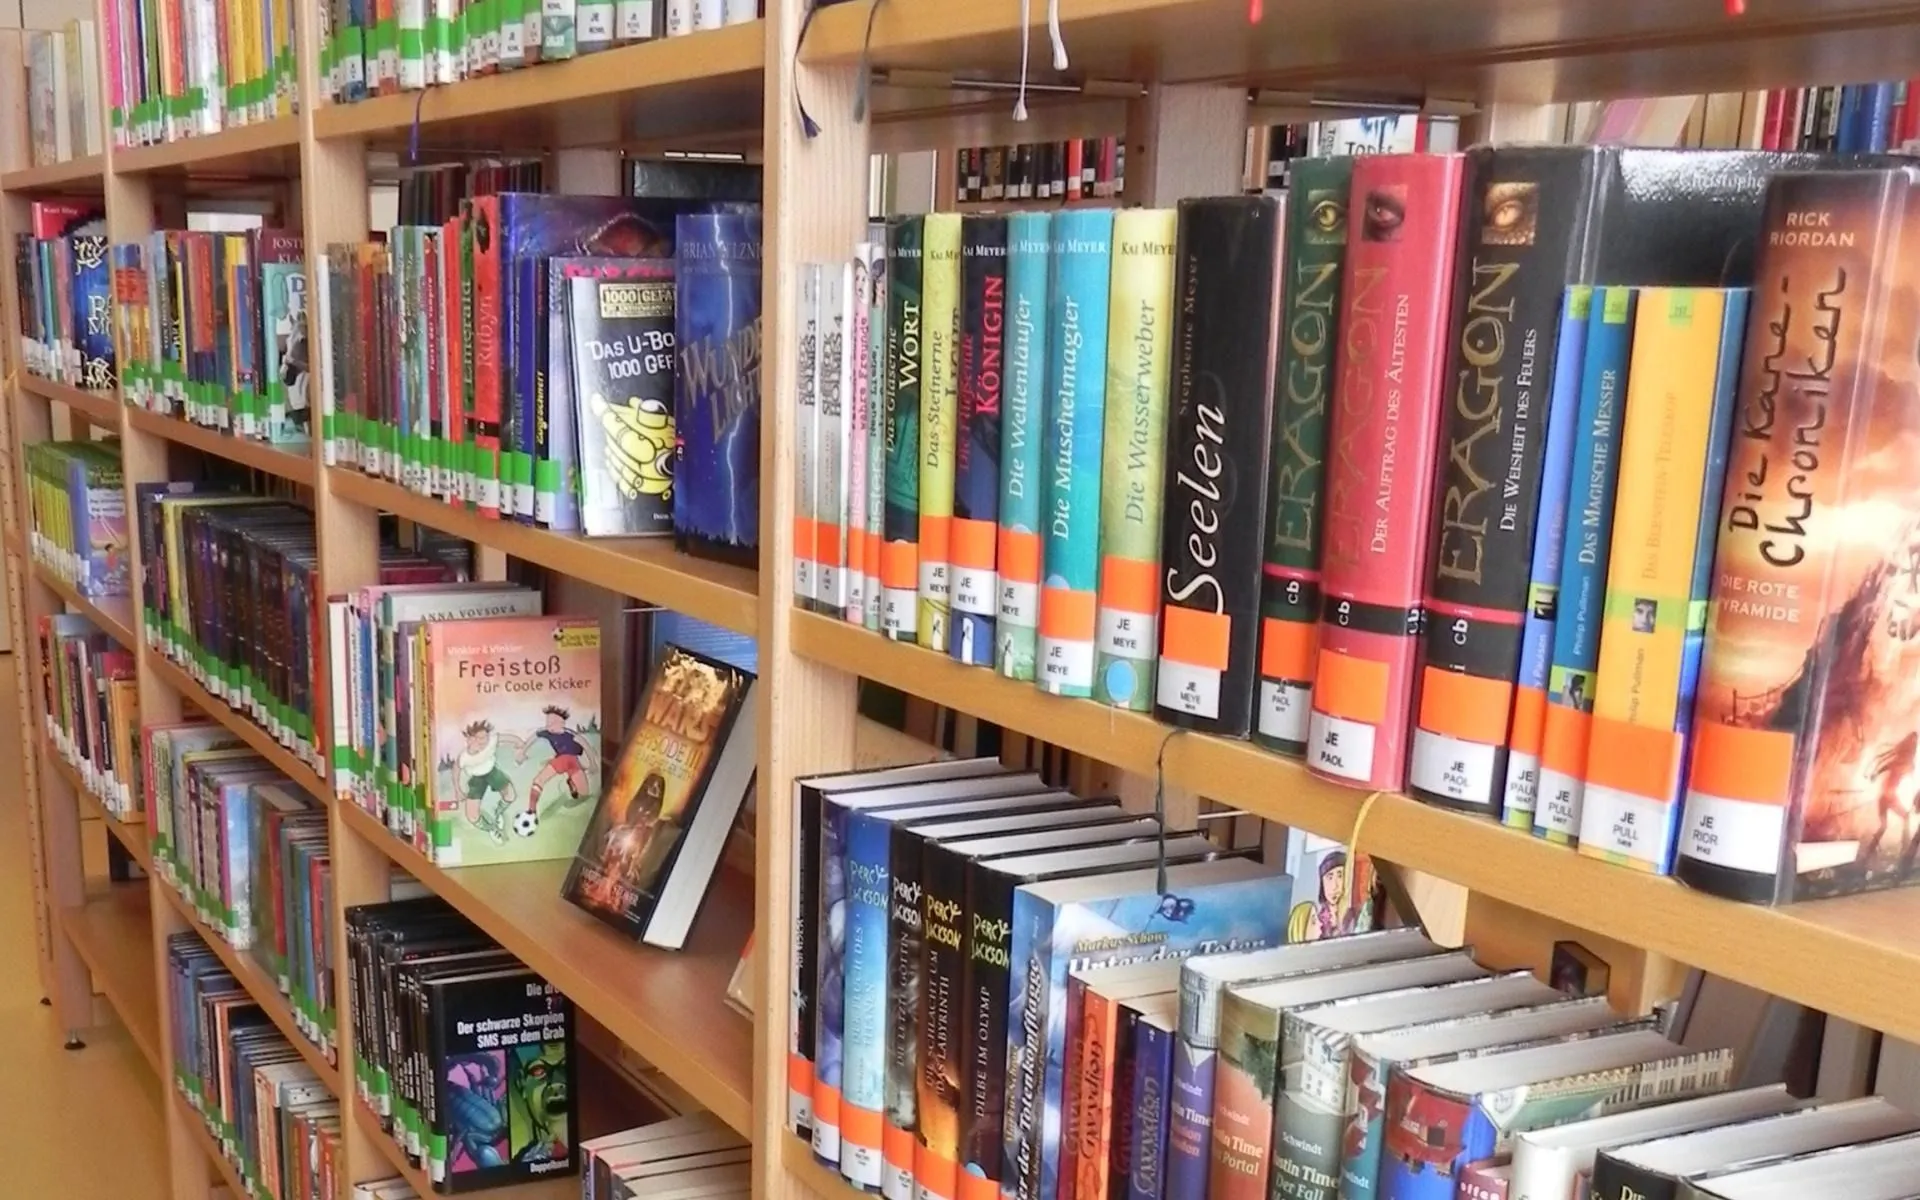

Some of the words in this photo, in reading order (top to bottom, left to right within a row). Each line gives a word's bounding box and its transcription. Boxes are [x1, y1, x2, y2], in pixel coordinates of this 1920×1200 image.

[1786, 212, 1831, 227] RICK
[975, 244, 1007, 257] MEYER
[1067, 239, 1108, 254] MEYER
[1769, 231, 1855, 247] RIORDAN
[604, 288, 638, 304] 1000
[477, 294, 499, 369] Rubyn
[1385, 294, 1409, 385] ÄLTESTEN
[586, 340, 625, 361] DAS
[900, 300, 920, 390] WORT
[976, 275, 1004, 415] KÖNIGIN
[1517, 327, 1537, 387] FEUERS
[608, 357, 641, 379] 1000
[930, 330, 943, 428] Steinerne
[1011, 293, 1034, 450] Wellenläufer
[1054, 295, 1081, 491] Muschelmagier
[1128, 299, 1156, 471] Wasserweber
[1274, 258, 1339, 554] ERAGON
[1387, 386, 1399, 421] DES
[1516, 391, 1529, 420] DES
[1592, 369, 1617, 438] MESSER
[1437, 256, 1521, 587] ERAGON
[1759, 266, 1847, 568] Chroniken
[927, 430, 941, 470] Das
[1503, 421, 1527, 500] WEISHEIT
[1010, 458, 1024, 499] Die
[1375, 425, 1397, 511] AUFTRAG
[1583, 442, 1609, 526] MAGISCHE
[1728, 453, 1768, 533] Die
[1125, 481, 1144, 525] Die
[1167, 402, 1227, 615] Seelen
[1053, 498, 1070, 541] Die
[1500, 502, 1516, 531] DIE
[1370, 515, 1387, 554] DER
[1578, 531, 1598, 567] DAS
[932, 567, 945, 578] JE
[960, 577, 972, 589] JE
[957, 593, 978, 605] MEYE
[1004, 586, 1015, 599] JE
[1720, 573, 1742, 588] DIE
[1747, 578, 1800, 600] ROTE
[458, 603, 517, 618] VOVSOVA
[886, 601, 895, 613] JE
[1001, 604, 1019, 617] MEYE
[1116, 617, 1132, 631] JE
[1049, 646, 1063, 658] JE
[1112, 635, 1137, 650] MEYE
[458, 655, 562, 679] Freistoß
[1046, 662, 1069, 676] MEYE
[475, 680, 500, 694] für
[504, 678, 544, 693] Coole
[548, 677, 592, 691] Kicker
[1179, 691, 1202, 705] MEYE
[1186, 681, 1197, 692] JE
[1324, 730, 1340, 747] JE
[1320, 750, 1345, 768] PAOL
[1450, 760, 1465, 774] JE
[1443, 772, 1469, 788] PAOL
[1518, 769, 1534, 783] JE
[1555, 789, 1571, 803] JE
[1548, 801, 1574, 819] PULL
[1620, 811, 1636, 825] JE
[1699, 814, 1715, 829] JE
[1612, 823, 1639, 842] PULL
[1692, 827, 1719, 846] RIOR
[850, 861, 889, 885] PERCY
[892, 875, 922, 906] PERCY
[926, 893, 962, 923] PERCY
[925, 920, 962, 952] JACKSON
[972, 912, 1011, 944] PERCY
[930, 949, 939, 975] UM
[526, 982, 542, 997] Die
[457, 1019, 474, 1036] Der
[476, 1015, 521, 1033] schwarze
[523, 1010, 565, 1029] Skorpion
[927, 983, 938, 1065] SCHLACHT
[938, 976, 950, 1055] LABYRINTH
[980, 985, 991, 1040] OLYMP
[477, 1033, 499, 1049] SMS
[502, 1033, 518, 1047] aus
[521, 1029, 541, 1044] dem
[543, 1026, 565, 1042] Grab
[1018, 955, 1043, 1133] Totenkopfflagge
[978, 1046, 988, 1069] IM
[935, 1056, 947, 1096] DAS
[975, 1071, 987, 1118] DIEBE
[1017, 1138, 1031, 1170] der
[1231, 1135, 1264, 1158] Time
[1222, 1151, 1260, 1177] Portal
[1296, 1183, 1324, 1200] Fall
